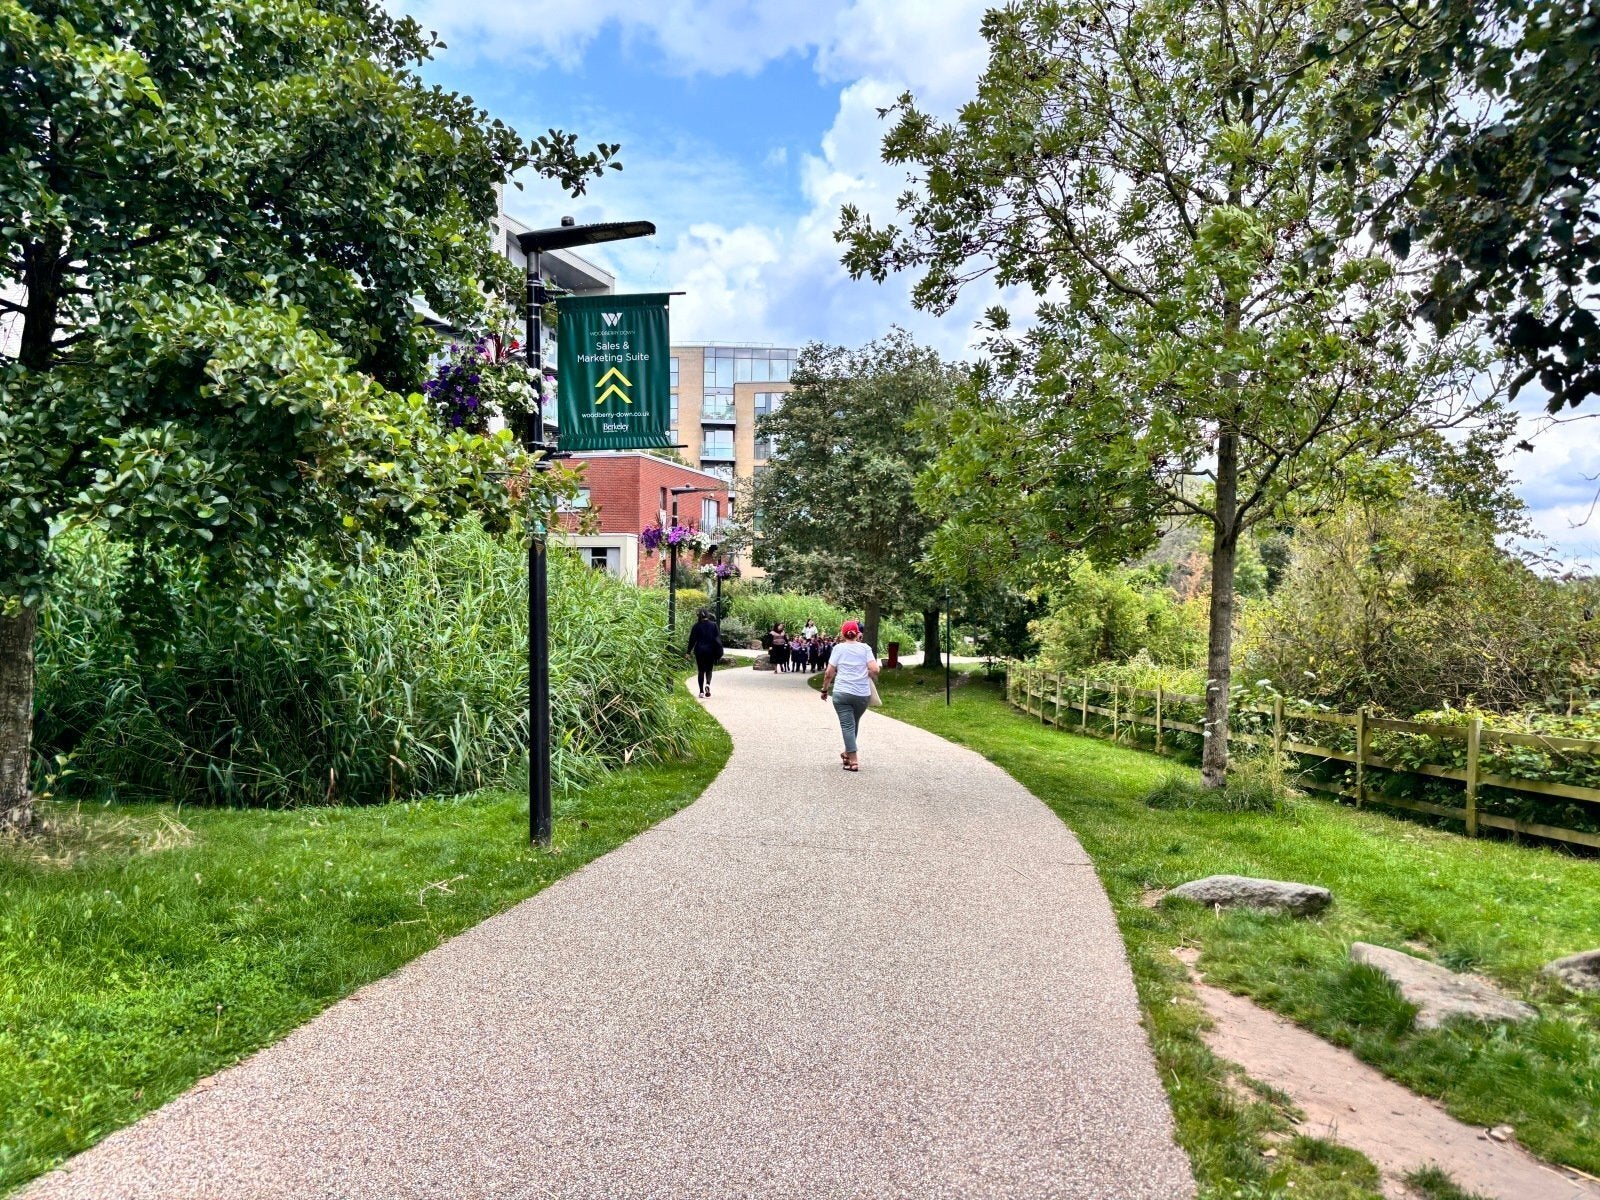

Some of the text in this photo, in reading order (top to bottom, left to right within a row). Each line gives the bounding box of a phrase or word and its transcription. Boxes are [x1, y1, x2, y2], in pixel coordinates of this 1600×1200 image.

[596, 341, 630, 350] Sales &
[577, 352, 650, 363] Marketing Suite
[603, 423, 629, 432] Berkeley
